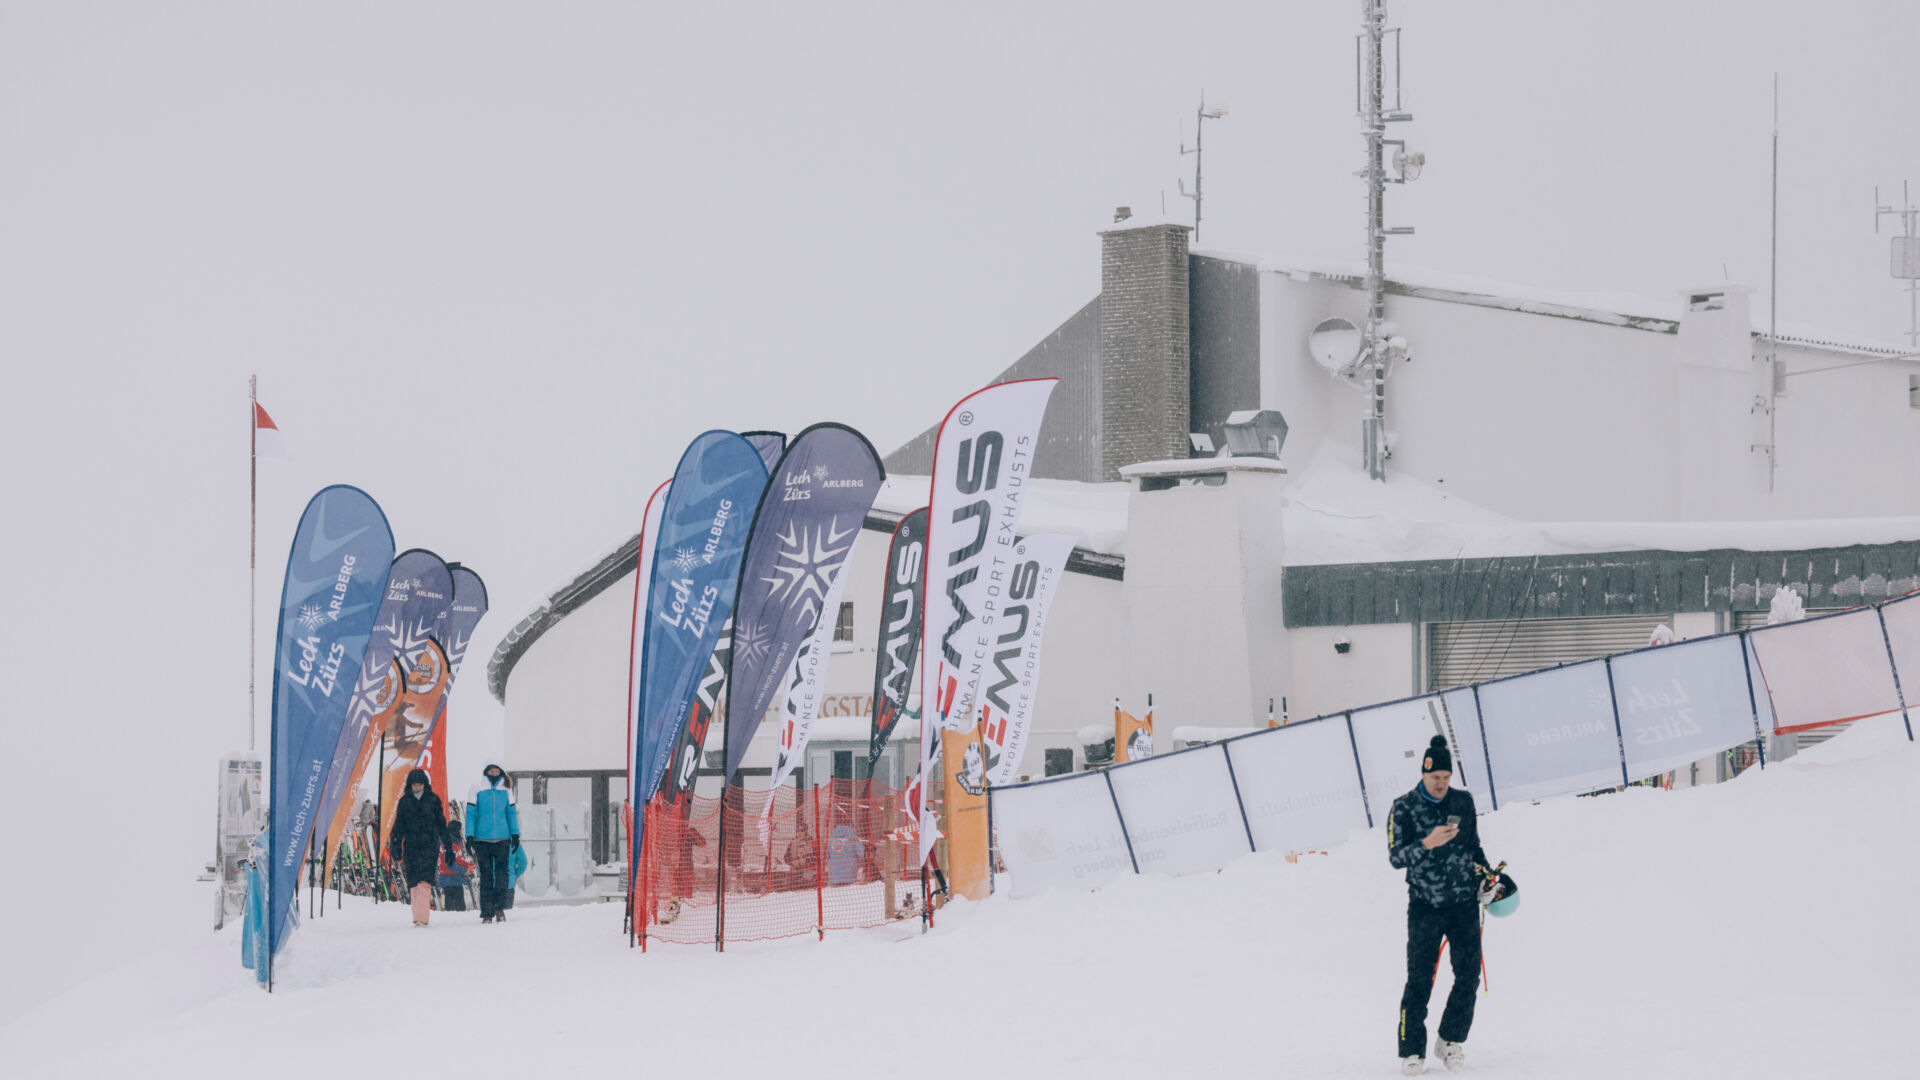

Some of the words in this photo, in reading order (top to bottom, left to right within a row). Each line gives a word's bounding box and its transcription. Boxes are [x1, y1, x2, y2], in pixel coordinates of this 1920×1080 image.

[783, 487, 811, 501] Zürs
[785, 470, 811, 487] Lech
[823, 480, 864, 488] ARLBERG
[702, 498, 732, 564] ARLBERG
[983, 556, 1006, 625] SPORT
[998, 435, 1030, 546] EXHAUSTS
[327, 554, 356, 620] ARLBERG
[387, 590, 408, 601] Zürs
[390, 579, 410, 590] Lech
[416, 590, 443, 600] ARLBERG
[660, 577, 694, 628] Lech
[683, 585, 718, 640] Zürs
[288, 635, 320, 687] Lech
[311, 642, 345, 698] Zürs
[1000, 693, 1028, 784] ERFORMANCE
[1023, 643, 1038, 688] SPORT
